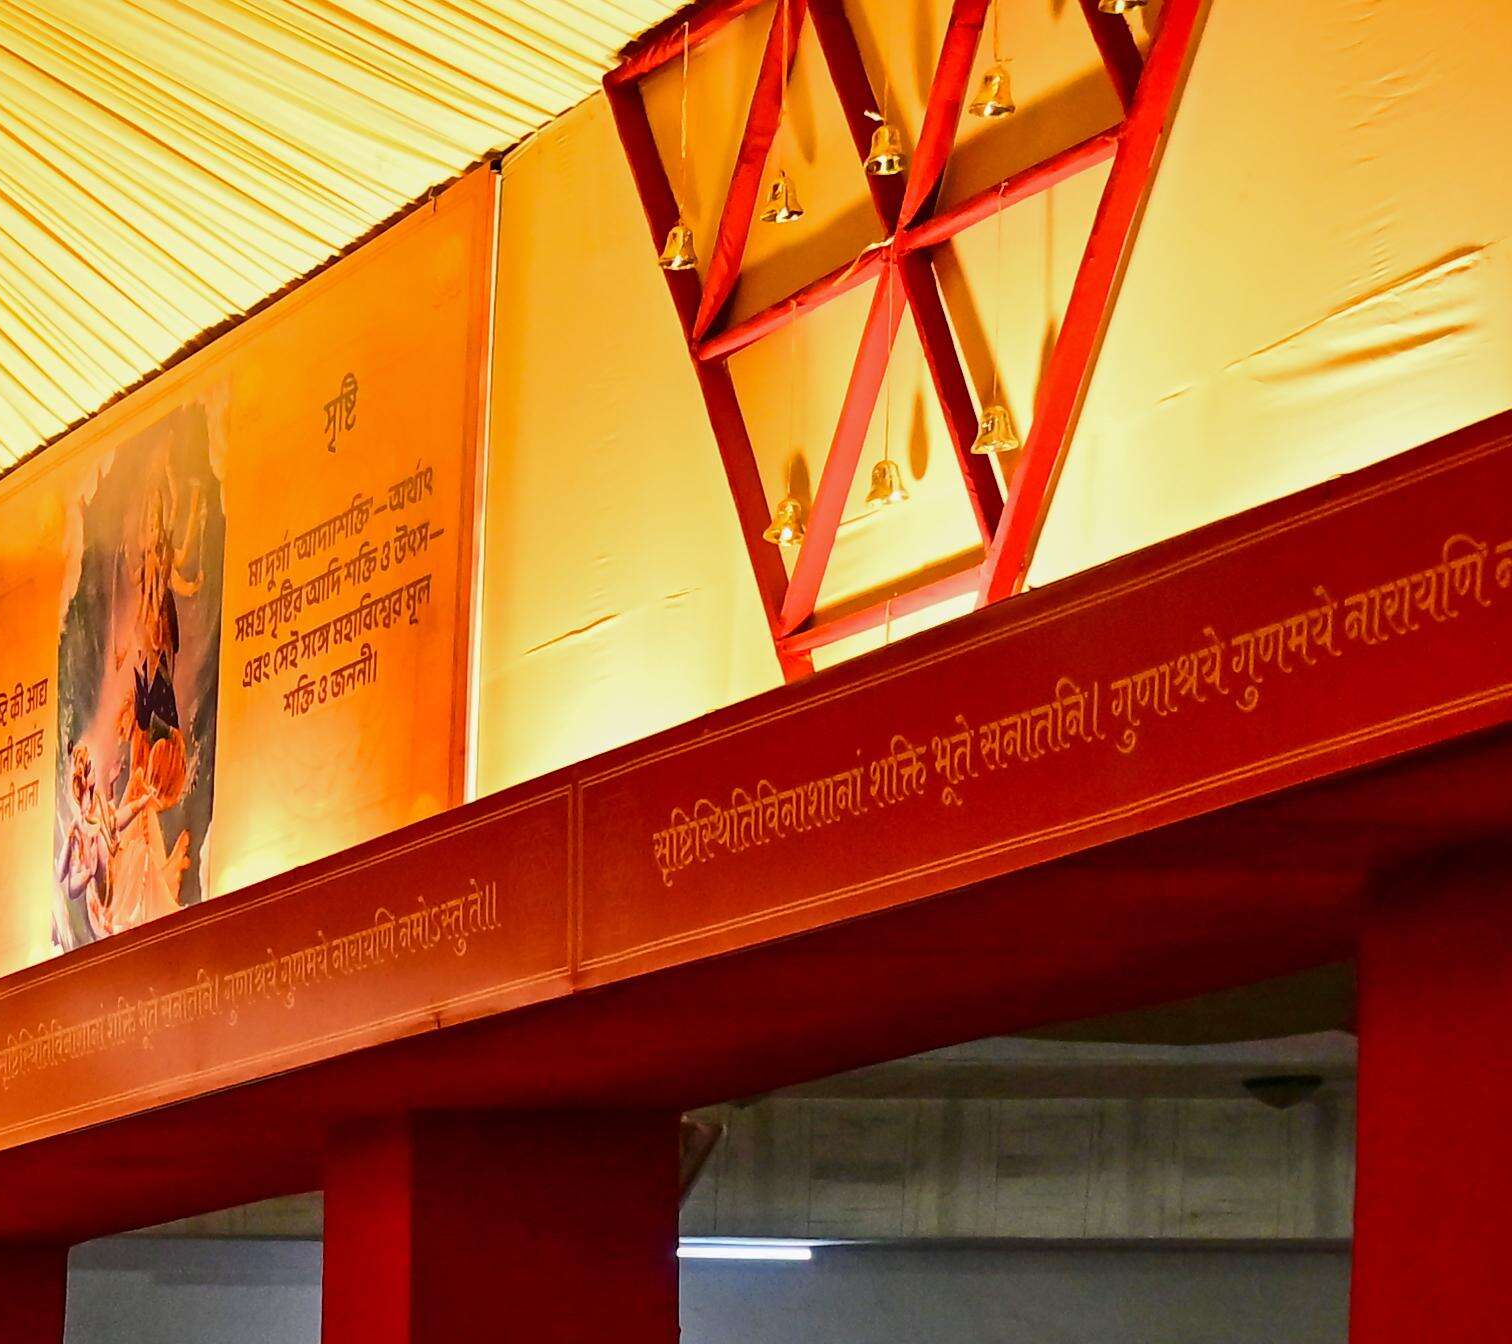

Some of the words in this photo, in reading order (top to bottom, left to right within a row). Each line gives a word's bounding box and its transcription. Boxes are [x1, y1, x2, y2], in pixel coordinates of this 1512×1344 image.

[323, 372, 359, 453] সৃষ্টি
[234, 603, 268, 642] সমগ্র
[267, 578, 303, 639] সৃষ্টির
[304, 557, 343, 605] আদি
[344, 541, 378, 586] শক্তি
[380, 540, 391, 571] ও
[248, 556, 263, 587] মা
[264, 529, 291, 592] দুর্গা
[242, 651, 271, 688] এবং
[274, 630, 300, 676] সেই
[300, 621, 332, 660] সঙ্গে
[332, 587, 404, 645] মহাবিশ্বের
[405, 574, 433, 625] মূল
[870, 734, 927, 808] शक्ति
[931, 713, 979, 806] भूते
[1110, 626, 1229, 754] गुणाश्रये
[1231, 584, 1342, 713] गुणमये
[1344, 533, 1491, 645] नारायणि
[10, 682, 24, 720] की
[283, 674, 316, 718] শক্তি
[317, 675, 328, 704] ও
[17, 779, 39, 812] माना
[224, 948, 280, 1026] गुणाश्रये
[280, 930, 332, 1009] गुणमये
[332, 907, 399, 976] नारायणि
